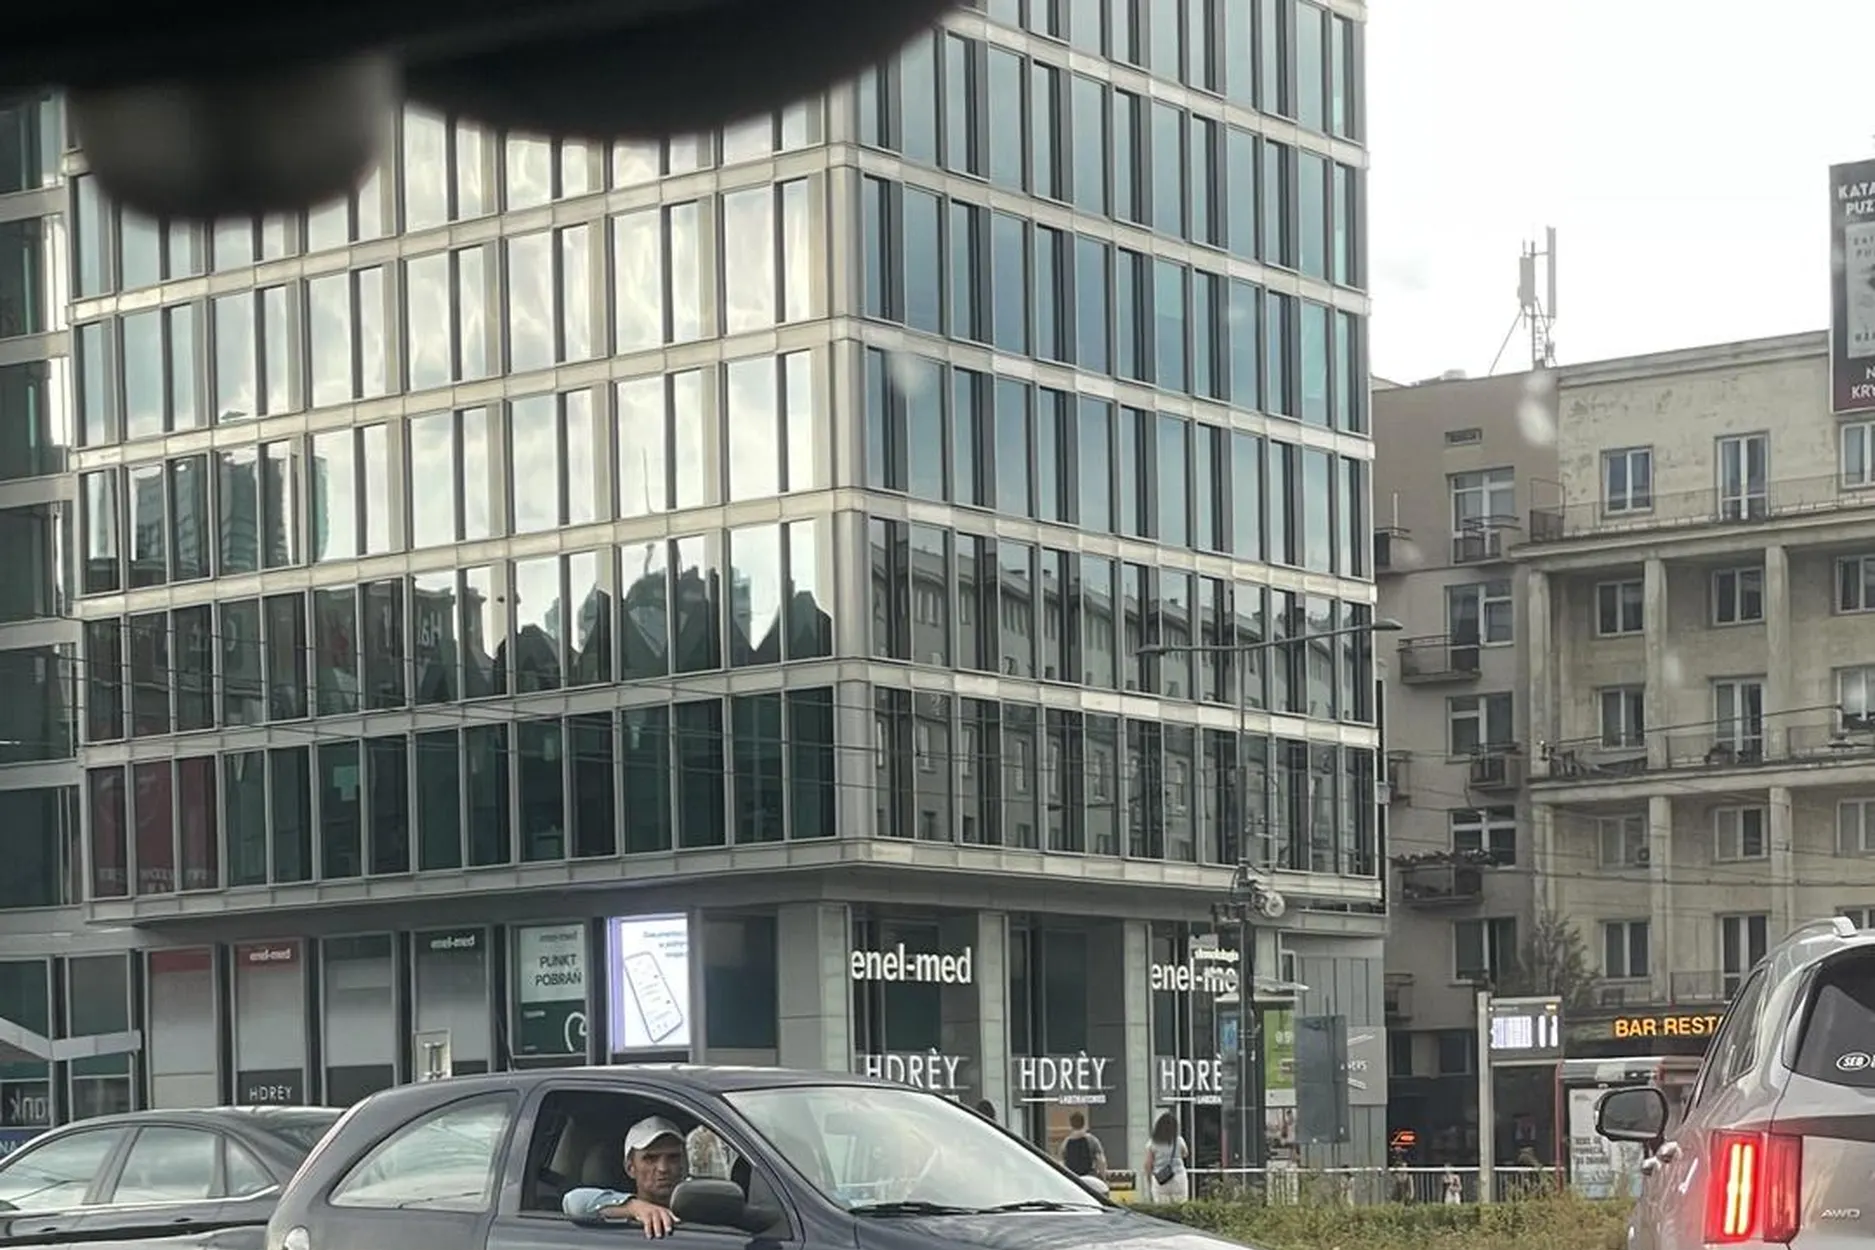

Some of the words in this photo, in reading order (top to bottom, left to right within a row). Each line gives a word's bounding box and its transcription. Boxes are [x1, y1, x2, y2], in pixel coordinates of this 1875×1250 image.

[851, 942, 972, 983] enel-med
[1151, 957, 1239, 992] enel-me
[1615, 1018, 1656, 1038] BAR
[1161, 1053, 1222, 1092] HDRÈ
[1820, 1208, 1860, 1219] AWD
